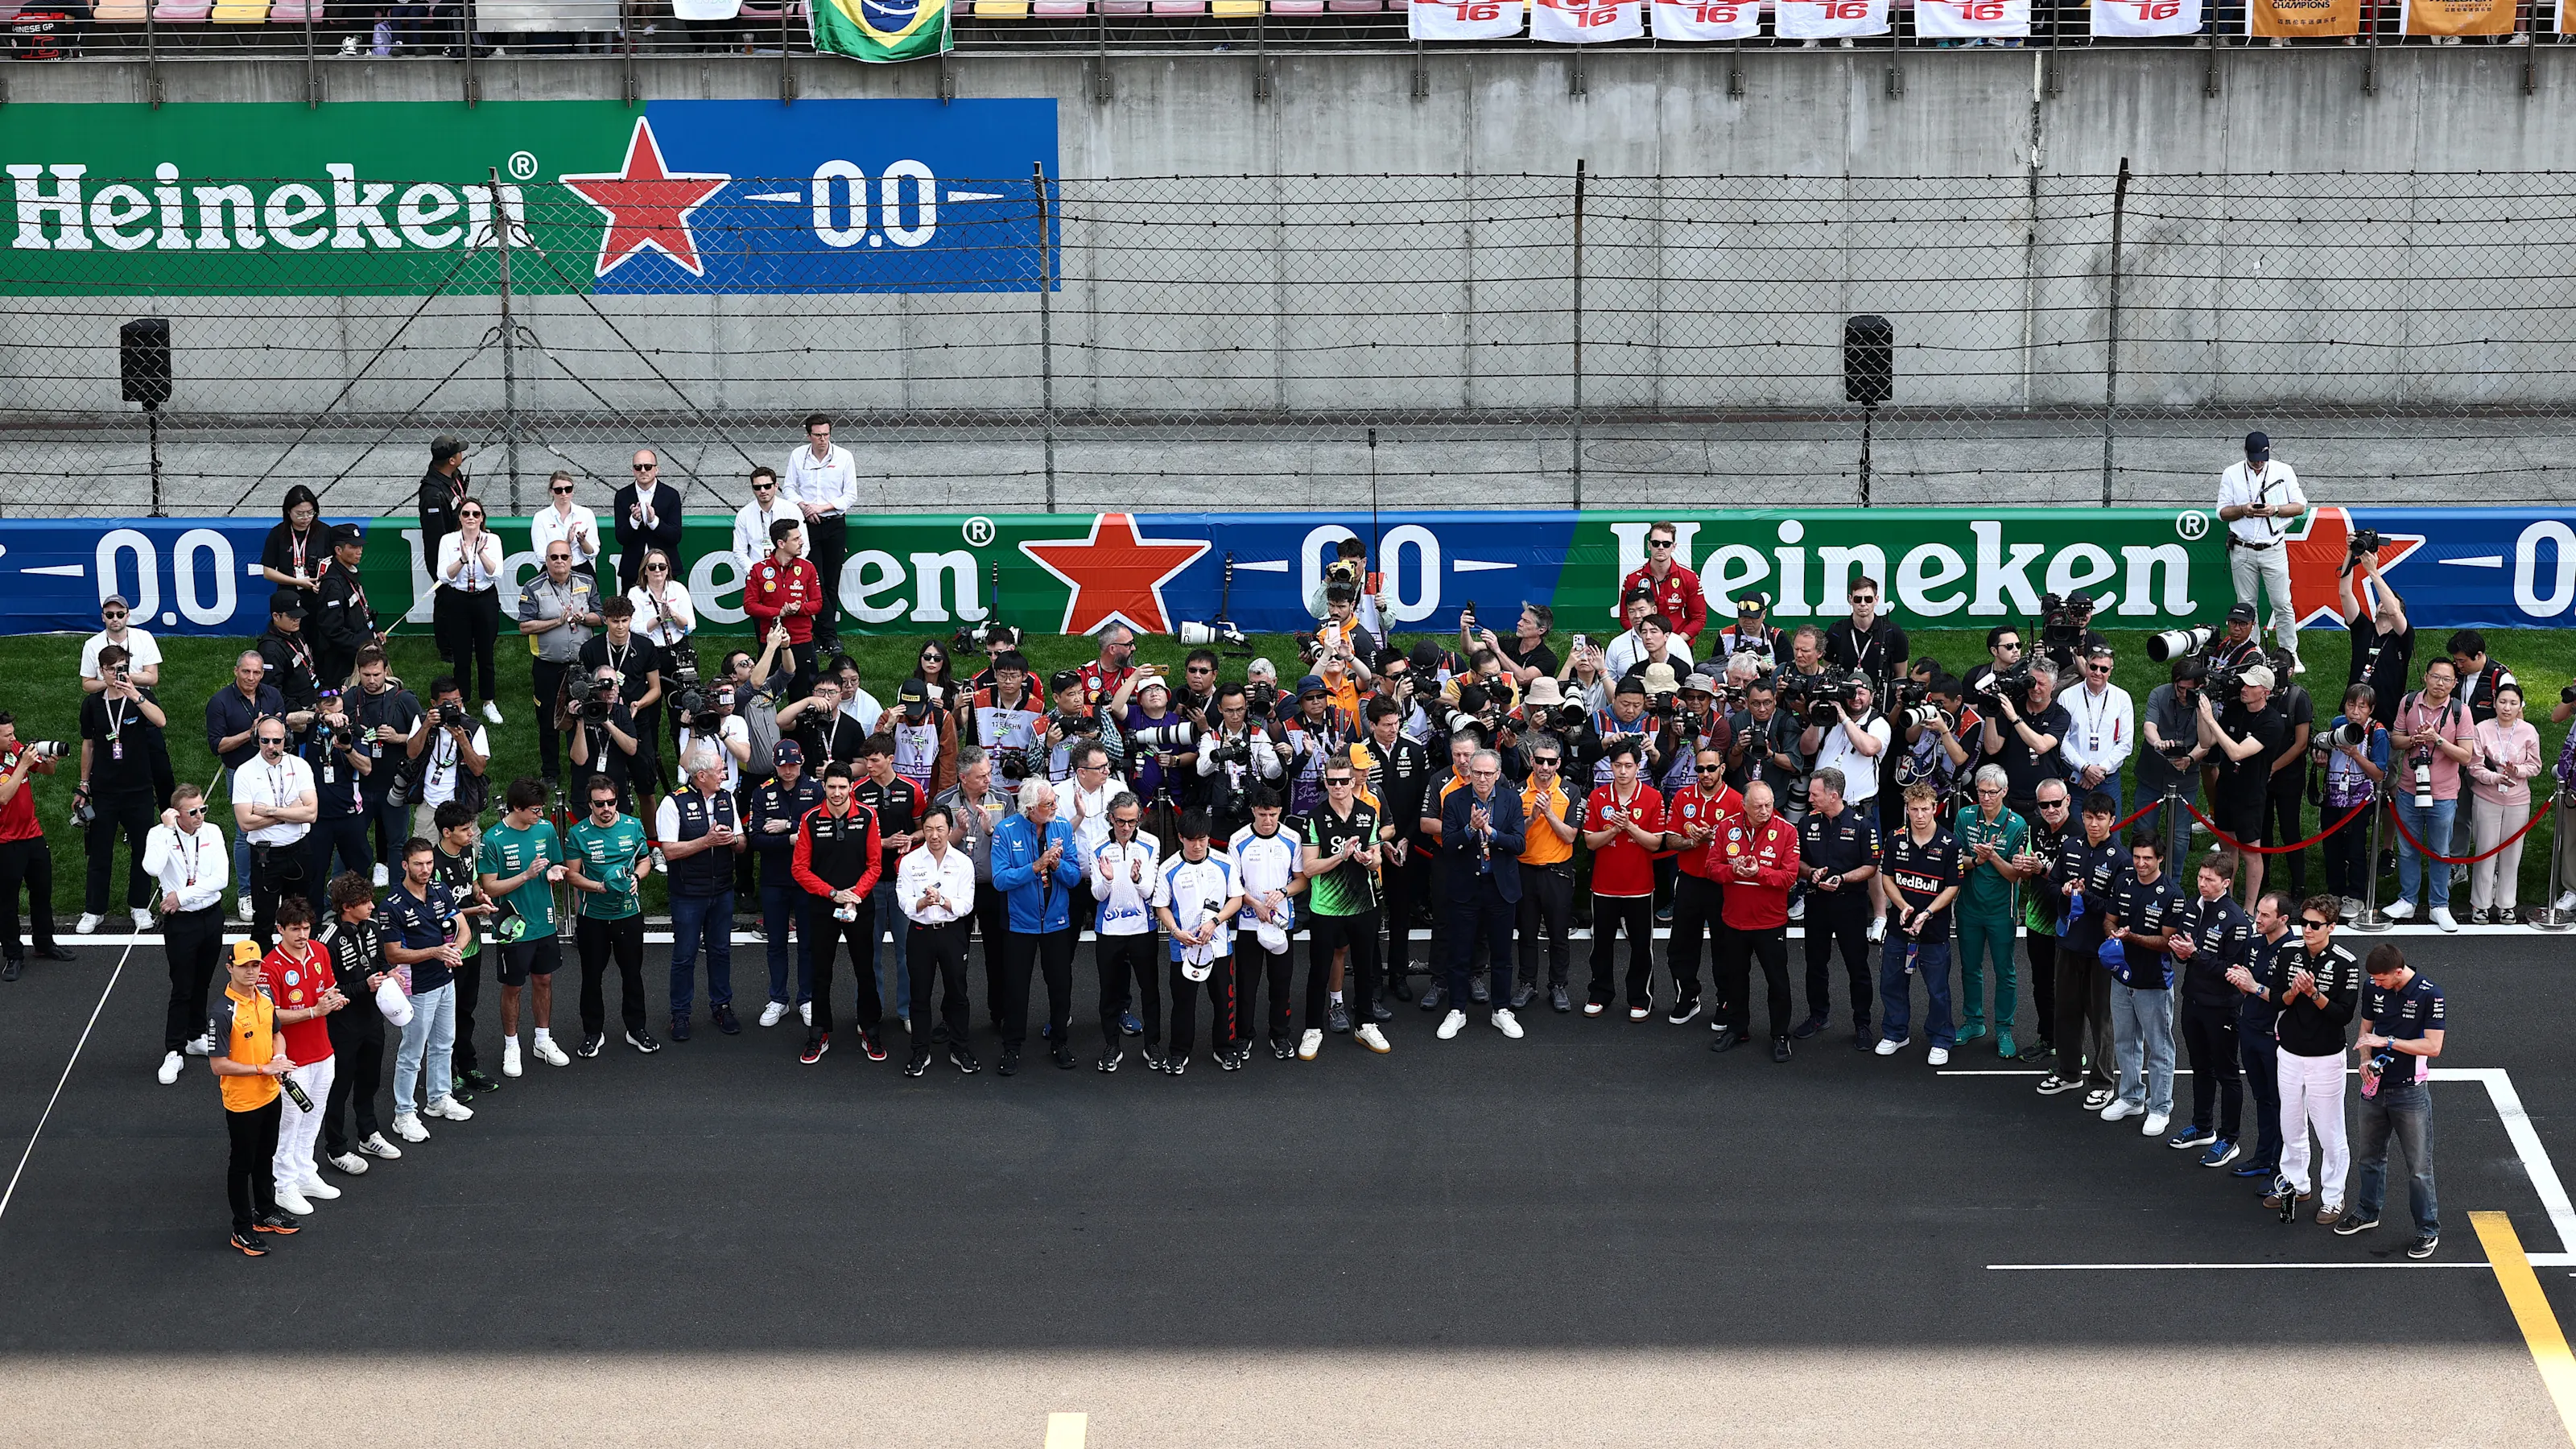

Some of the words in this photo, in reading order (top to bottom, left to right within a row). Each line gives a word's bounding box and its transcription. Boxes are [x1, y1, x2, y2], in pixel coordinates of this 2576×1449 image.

[1447, 5, 1500, 21] 16
[1817, 2, 1868, 19] 16
[1954, 4, 2004, 20] 16
[2131, 2, 2180, 20] 16
[2273, 1, 2330, 9] CHAMPIONS
[1569, 7, 1617, 27] 16
[1687, 6, 1738, 23] 16
[6, 162, 535, 251] Heineken
[812, 159, 936, 248] 0.0
[1610, 519, 2198, 617] Heineken
[2514, 520, 2576, 617] 0
[96, 528, 237, 625] 0.0
[778, 749, 783, 757] 1
[1095, 836, 1108, 845] HUGO
[1137, 835, 1151, 843] HUGO
[1231, 832, 1245, 842] HUGO
[1278, 830, 1291, 840] HUGO
[1330, 835, 1363, 854] Ste
[1165, 860, 1178, 870] HUGO
[623, 903, 632, 911] 14
